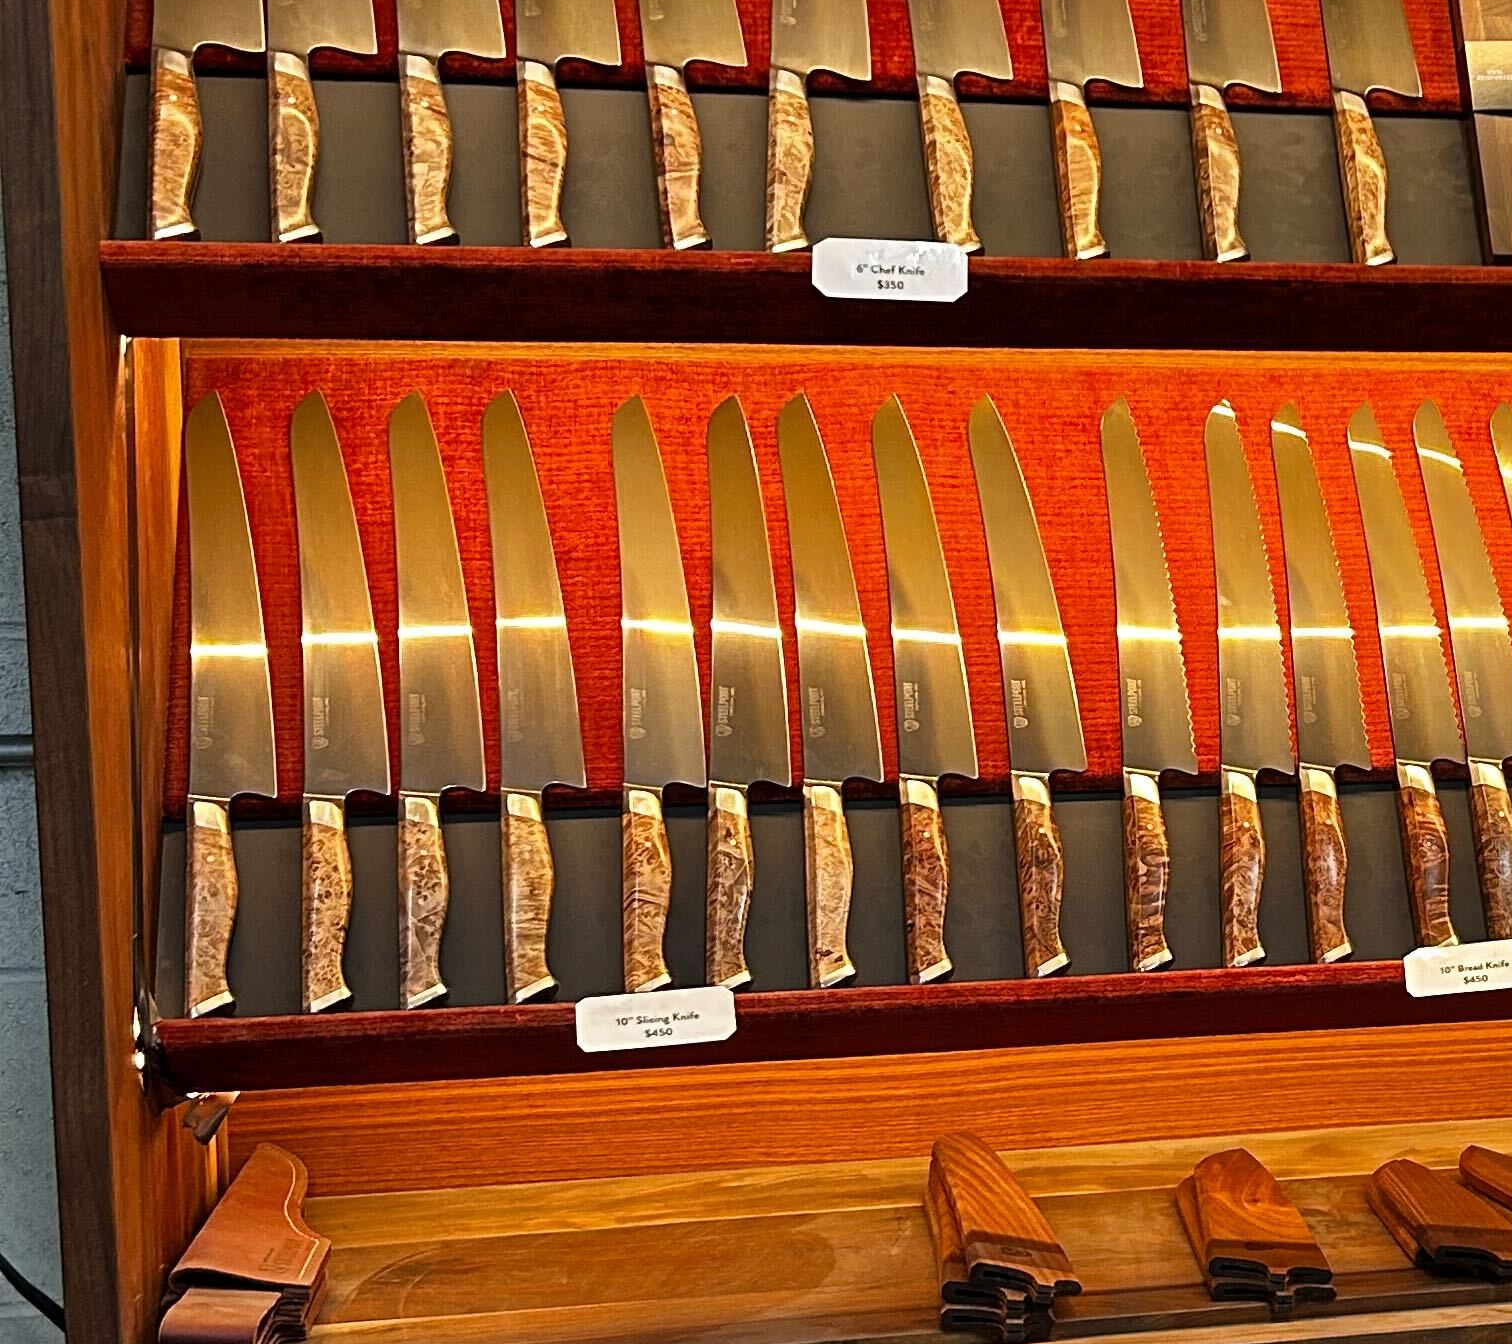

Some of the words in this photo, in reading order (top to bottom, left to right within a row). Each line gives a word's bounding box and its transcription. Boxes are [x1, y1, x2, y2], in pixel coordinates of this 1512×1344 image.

[856, 263, 868, 273] 6"
[870, 265, 895, 275] Chef
[898, 265, 925, 276] Knife
[878, 279, 904, 290] $350
[1440, 965, 1455, 974] 10"
[1458, 963, 1483, 973] Bread
[1486, 959, 1510, 969] Knife
[1464, 974, 1488, 984] $450
[616, 1016, 633, 1026] 10"
[636, 1014, 670, 1025] Slicing
[672, 1012, 699, 1022] Knife
[645, 1027, 673, 1038] $450
